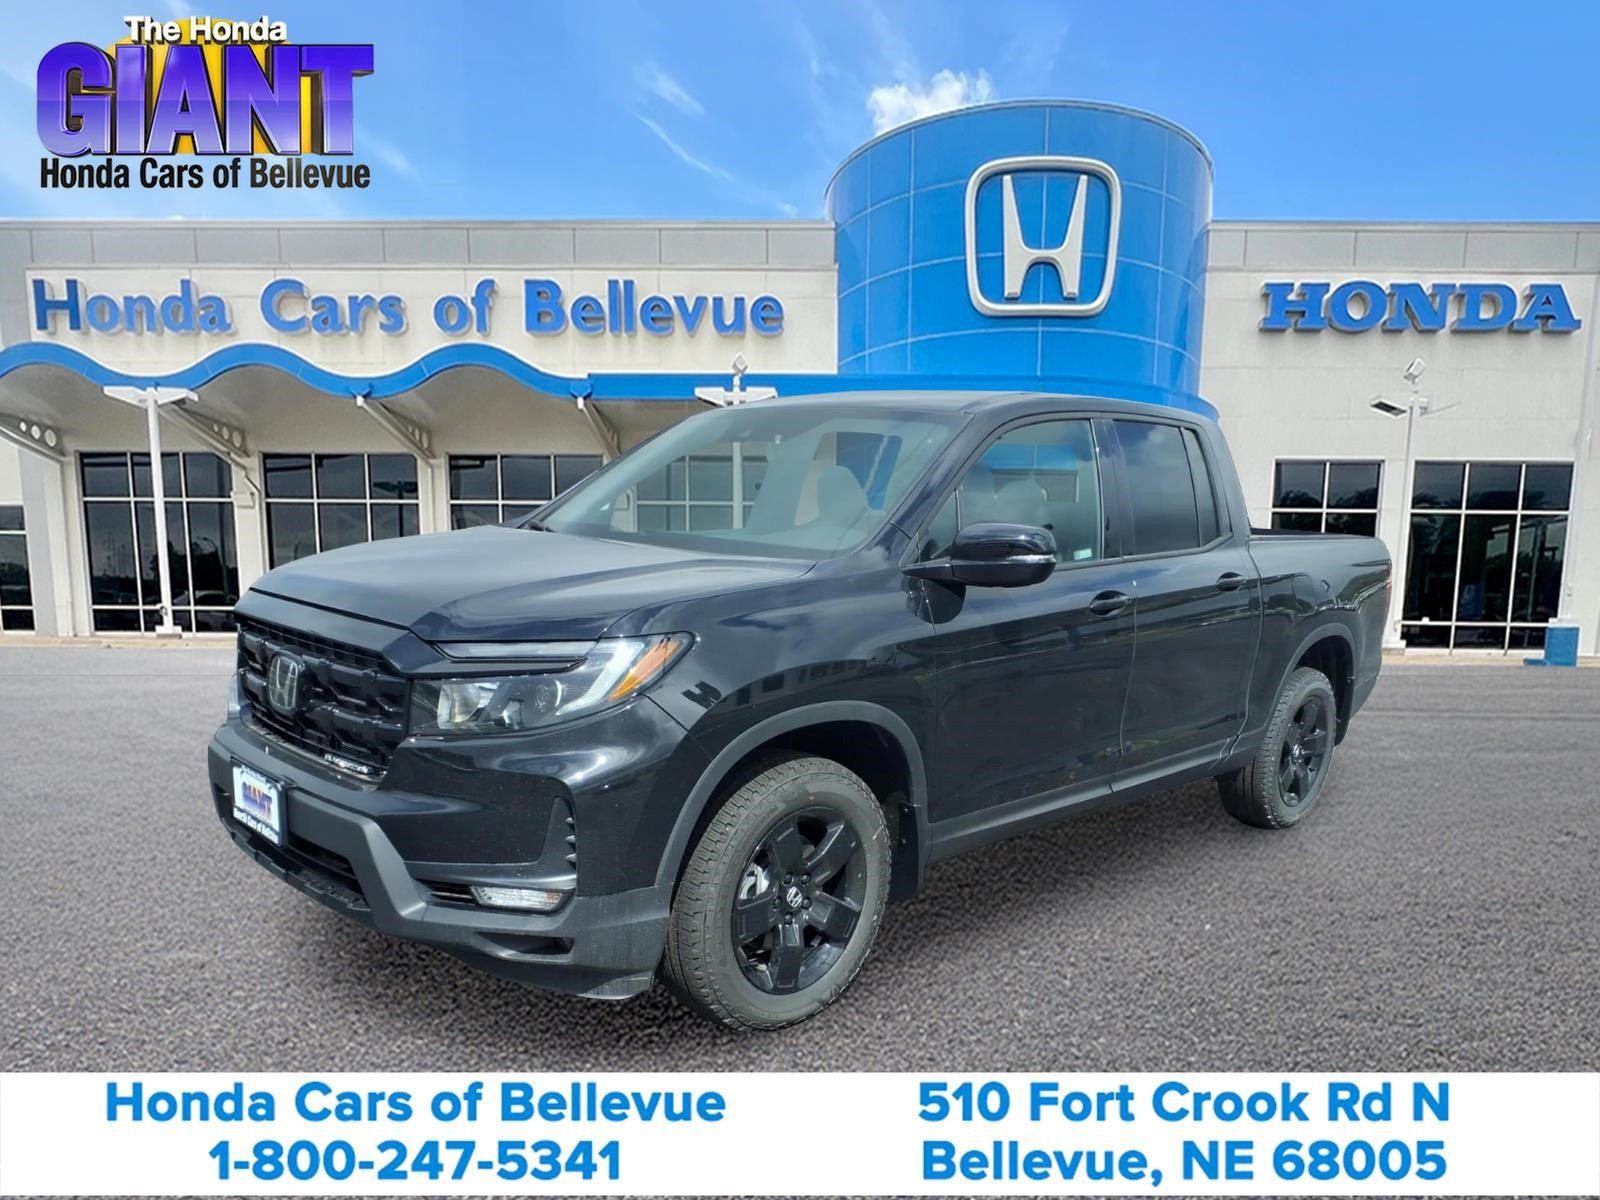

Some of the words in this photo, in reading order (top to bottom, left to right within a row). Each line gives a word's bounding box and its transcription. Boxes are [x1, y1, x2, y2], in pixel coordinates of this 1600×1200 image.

[33, 279, 234, 333] Honda
[260, 278, 408, 334] Cars
[433, 277, 498, 334] of
[524, 278, 785, 335] Bellevue
[1260, 280, 1582, 333] HONDA
